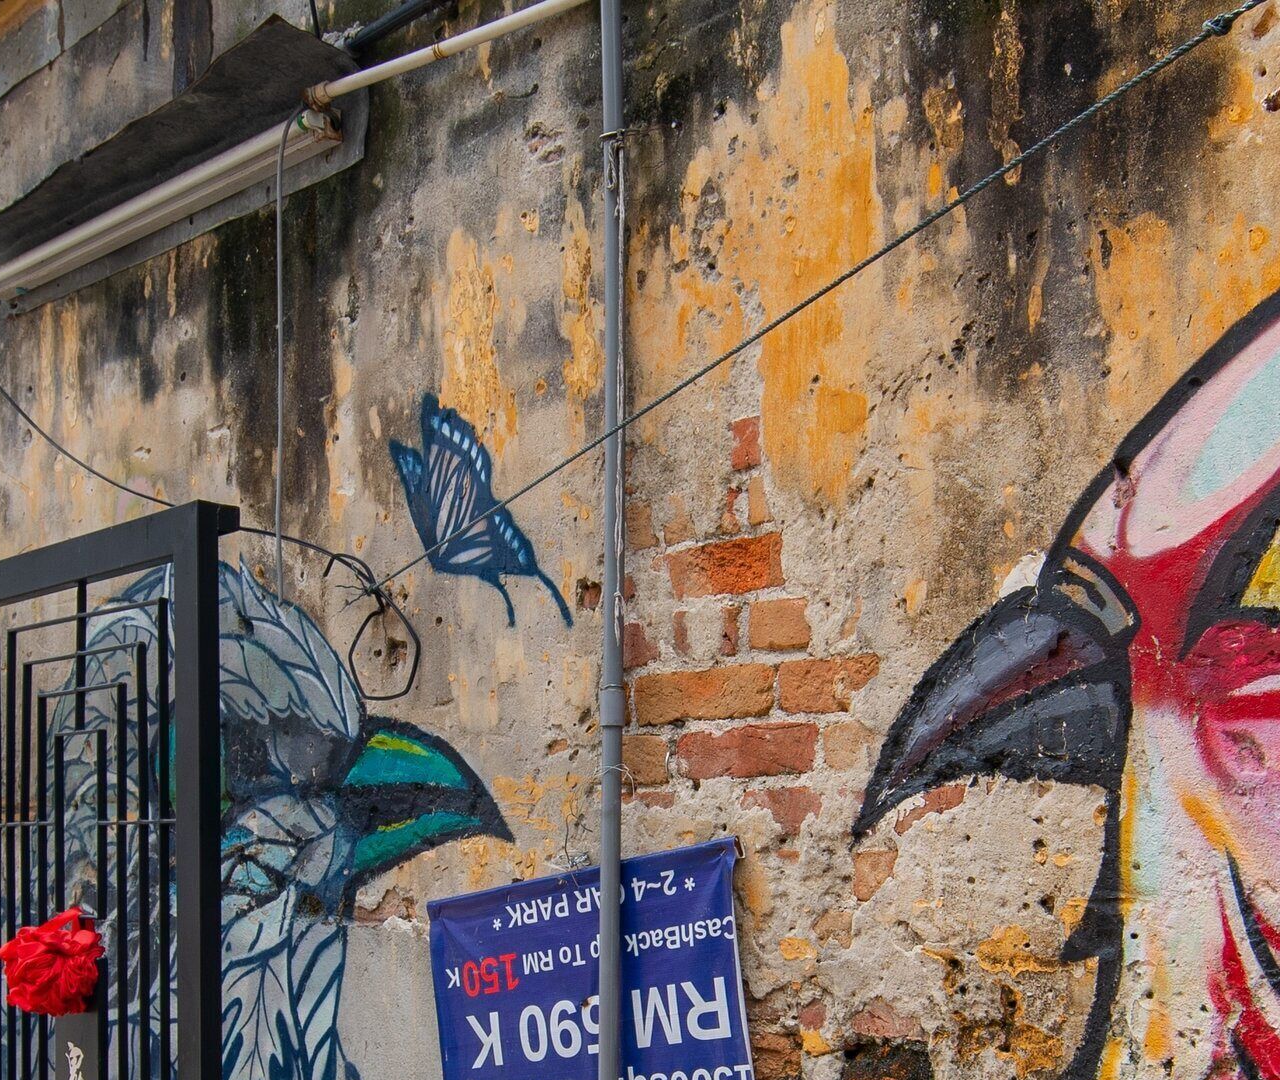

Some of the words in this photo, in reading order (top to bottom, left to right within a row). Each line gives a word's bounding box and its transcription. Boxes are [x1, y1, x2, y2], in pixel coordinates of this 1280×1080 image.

[631, 869, 676, 903] 2~4
[504, 893, 569, 929] PARK
[558, 943, 586, 967] To
[624, 915, 736, 957] CashBack
[522, 949, 554, 976] RM
[518, 995, 600, 1063] 590
[630, 976, 732, 1050] RM
[465, 1011, 505, 1069] K
